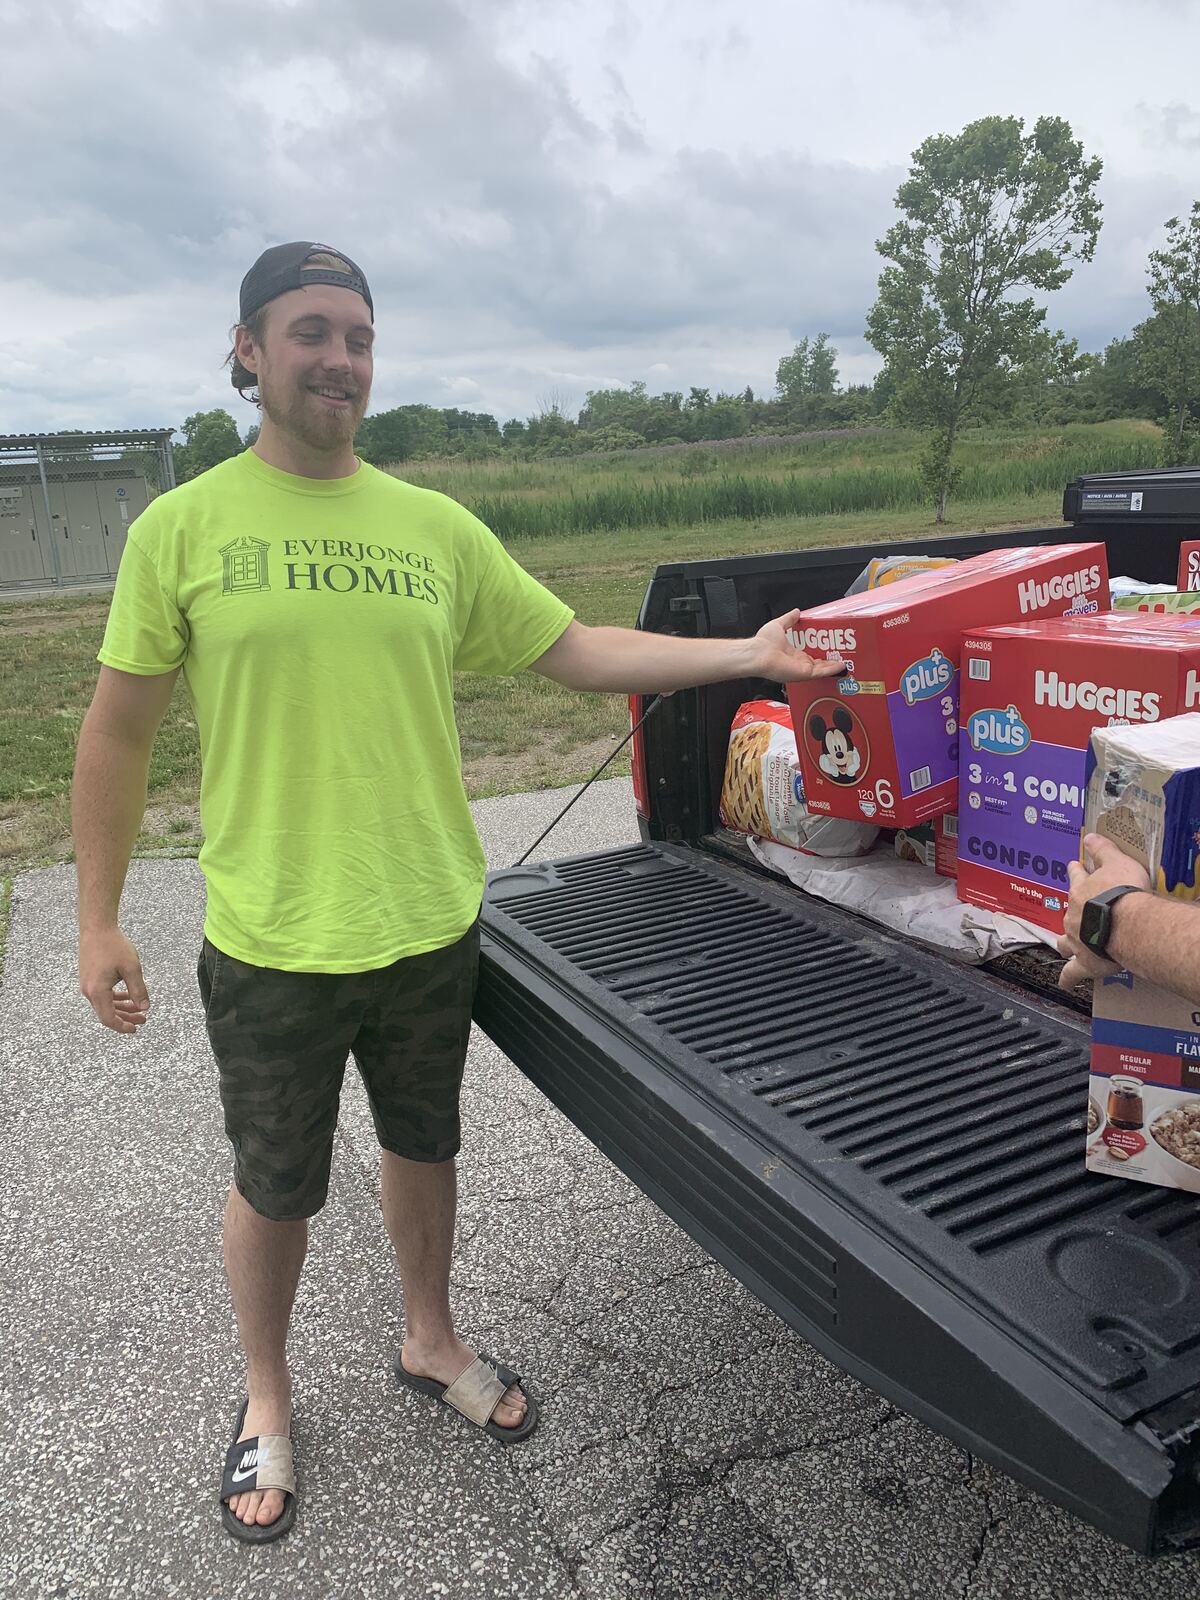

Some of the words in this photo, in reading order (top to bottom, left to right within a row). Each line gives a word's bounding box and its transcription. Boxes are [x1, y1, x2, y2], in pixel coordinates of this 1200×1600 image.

[283, 539, 435, 574] EVERJONGE
[1188, 551, 1200, 573] S
[283, 562, 439, 605] HOMES
[1018, 565, 1100, 614] HUGGIES
[839, 679, 859, 694] plus
[906, 664, 950, 702] plus
[1035, 670, 1161, 722] HUGGIES
[940, 696, 953, 716] 3
[974, 714, 1025, 748] plus
[875, 778, 895, 809] 6
[968, 763, 982, 784] 3
[1003, 771, 1017, 793] 1
[857, 789, 874, 801] 120
[967, 836, 1068, 883] CONFOR
[1010, 882, 1031, 895] That's
[1031, 890, 1043, 899] the
[1120, 1054, 1152, 1066] REGULAR
